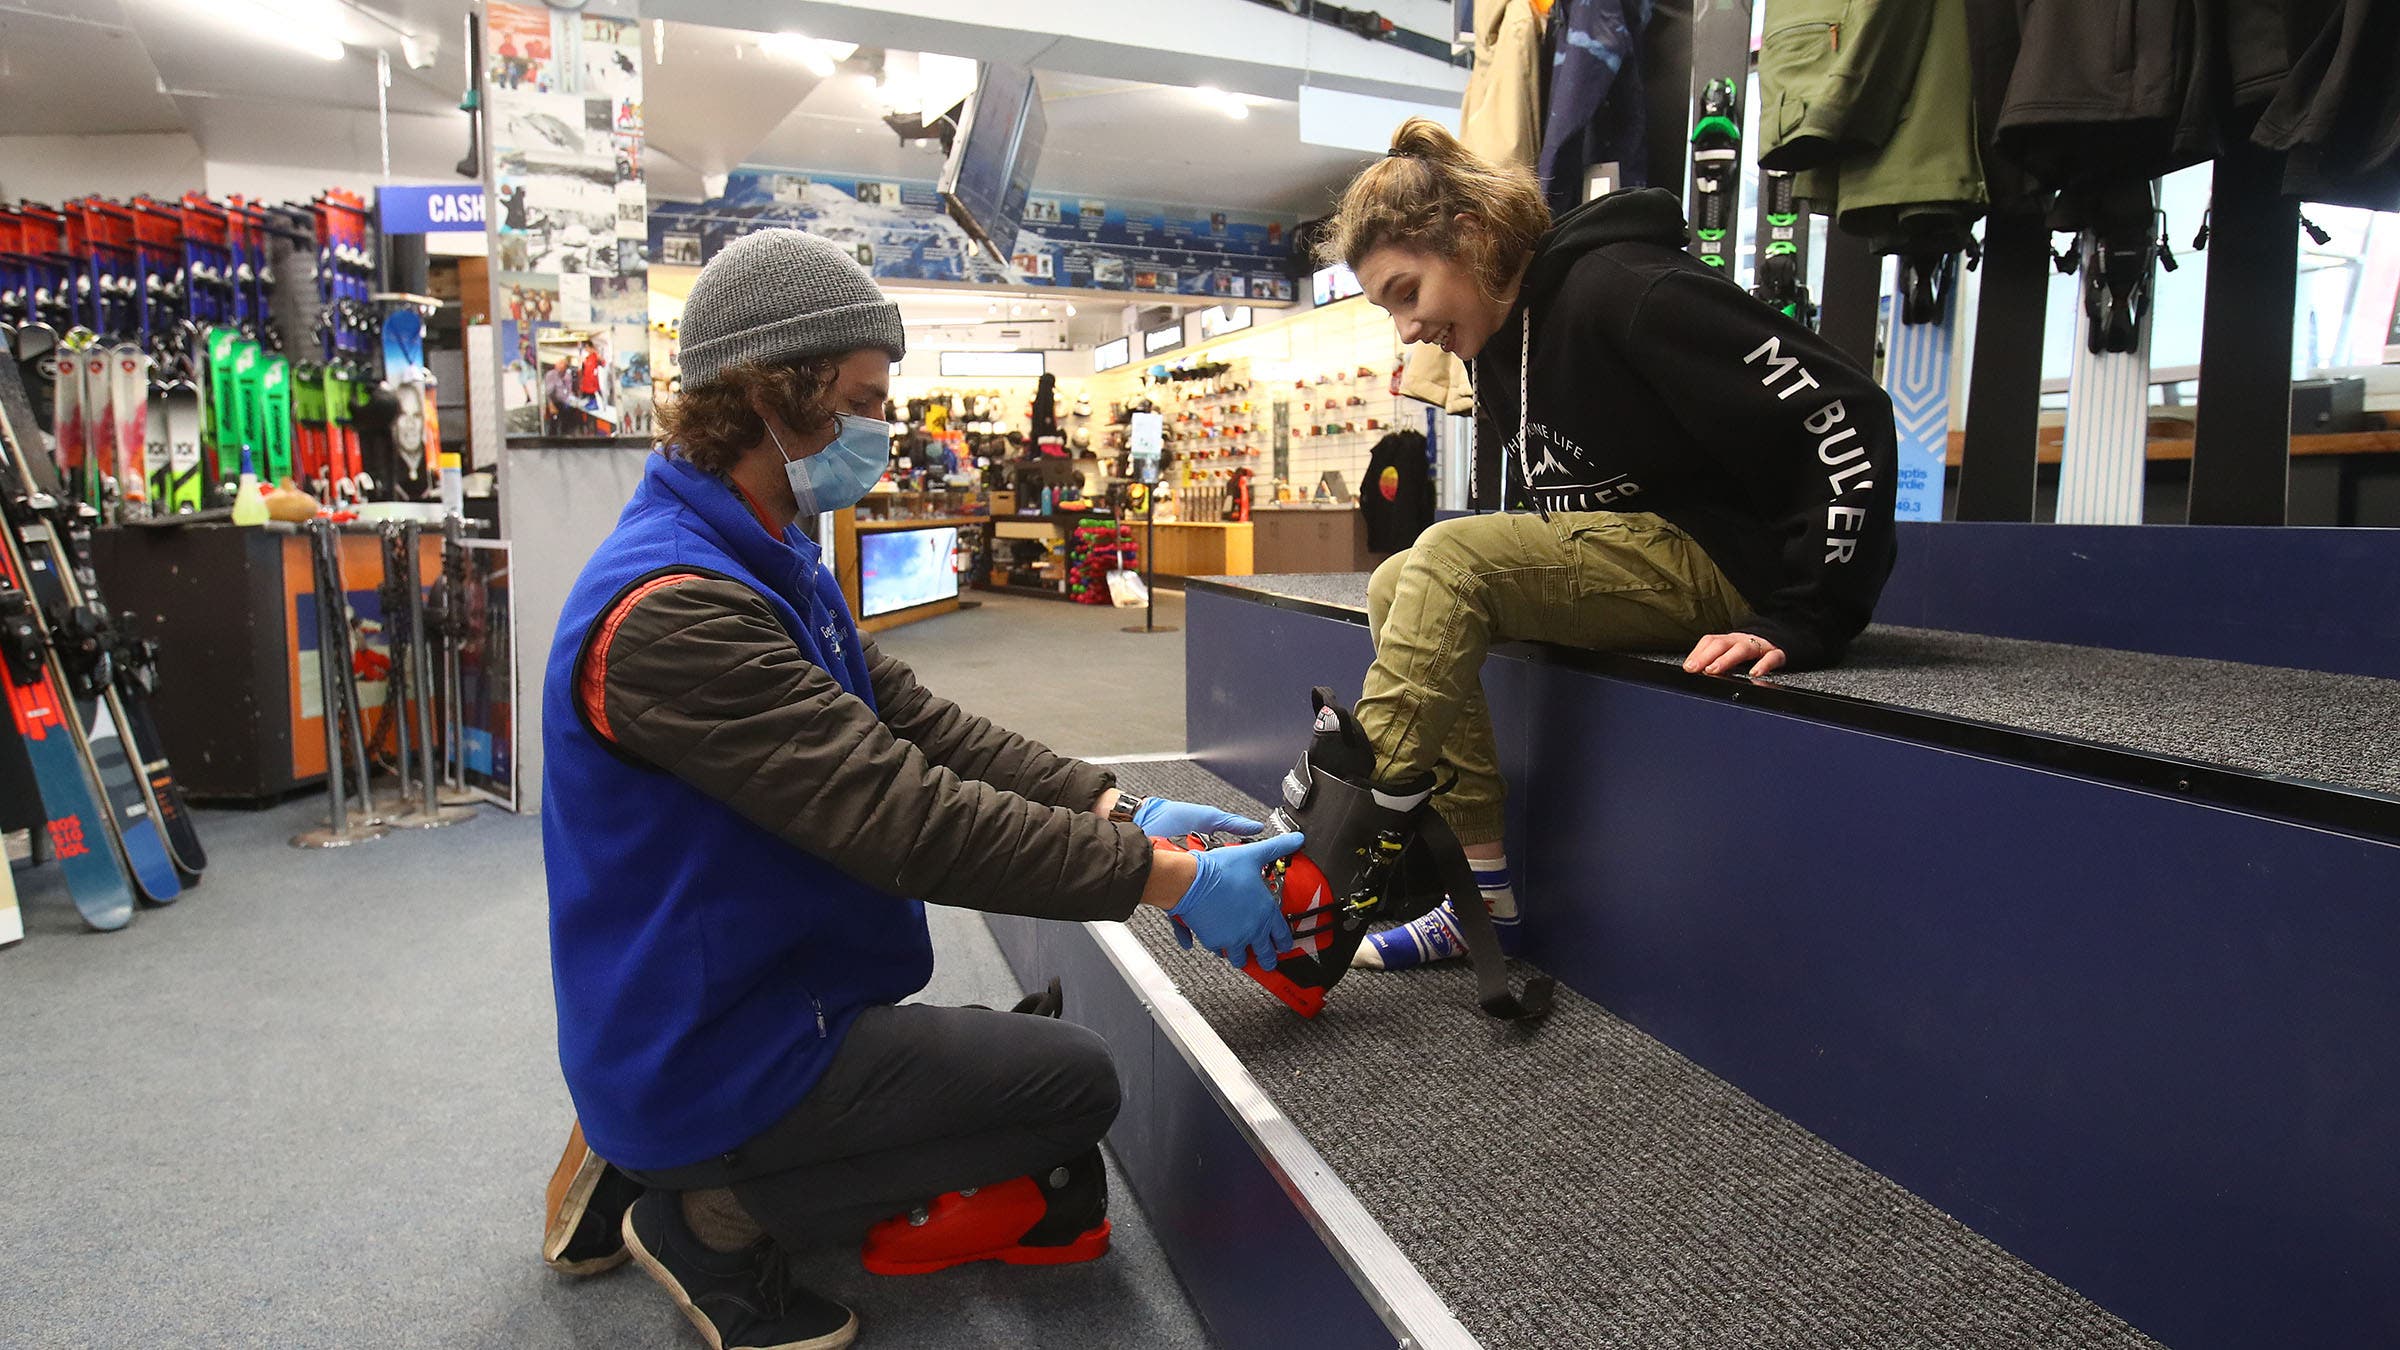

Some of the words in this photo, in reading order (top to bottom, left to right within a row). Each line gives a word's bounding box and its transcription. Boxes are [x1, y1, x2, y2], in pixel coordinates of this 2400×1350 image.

[1554, 431, 1584, 460] LIFE
[1743, 336, 1820, 400] MT
[1803, 399, 1874, 564] BULER
